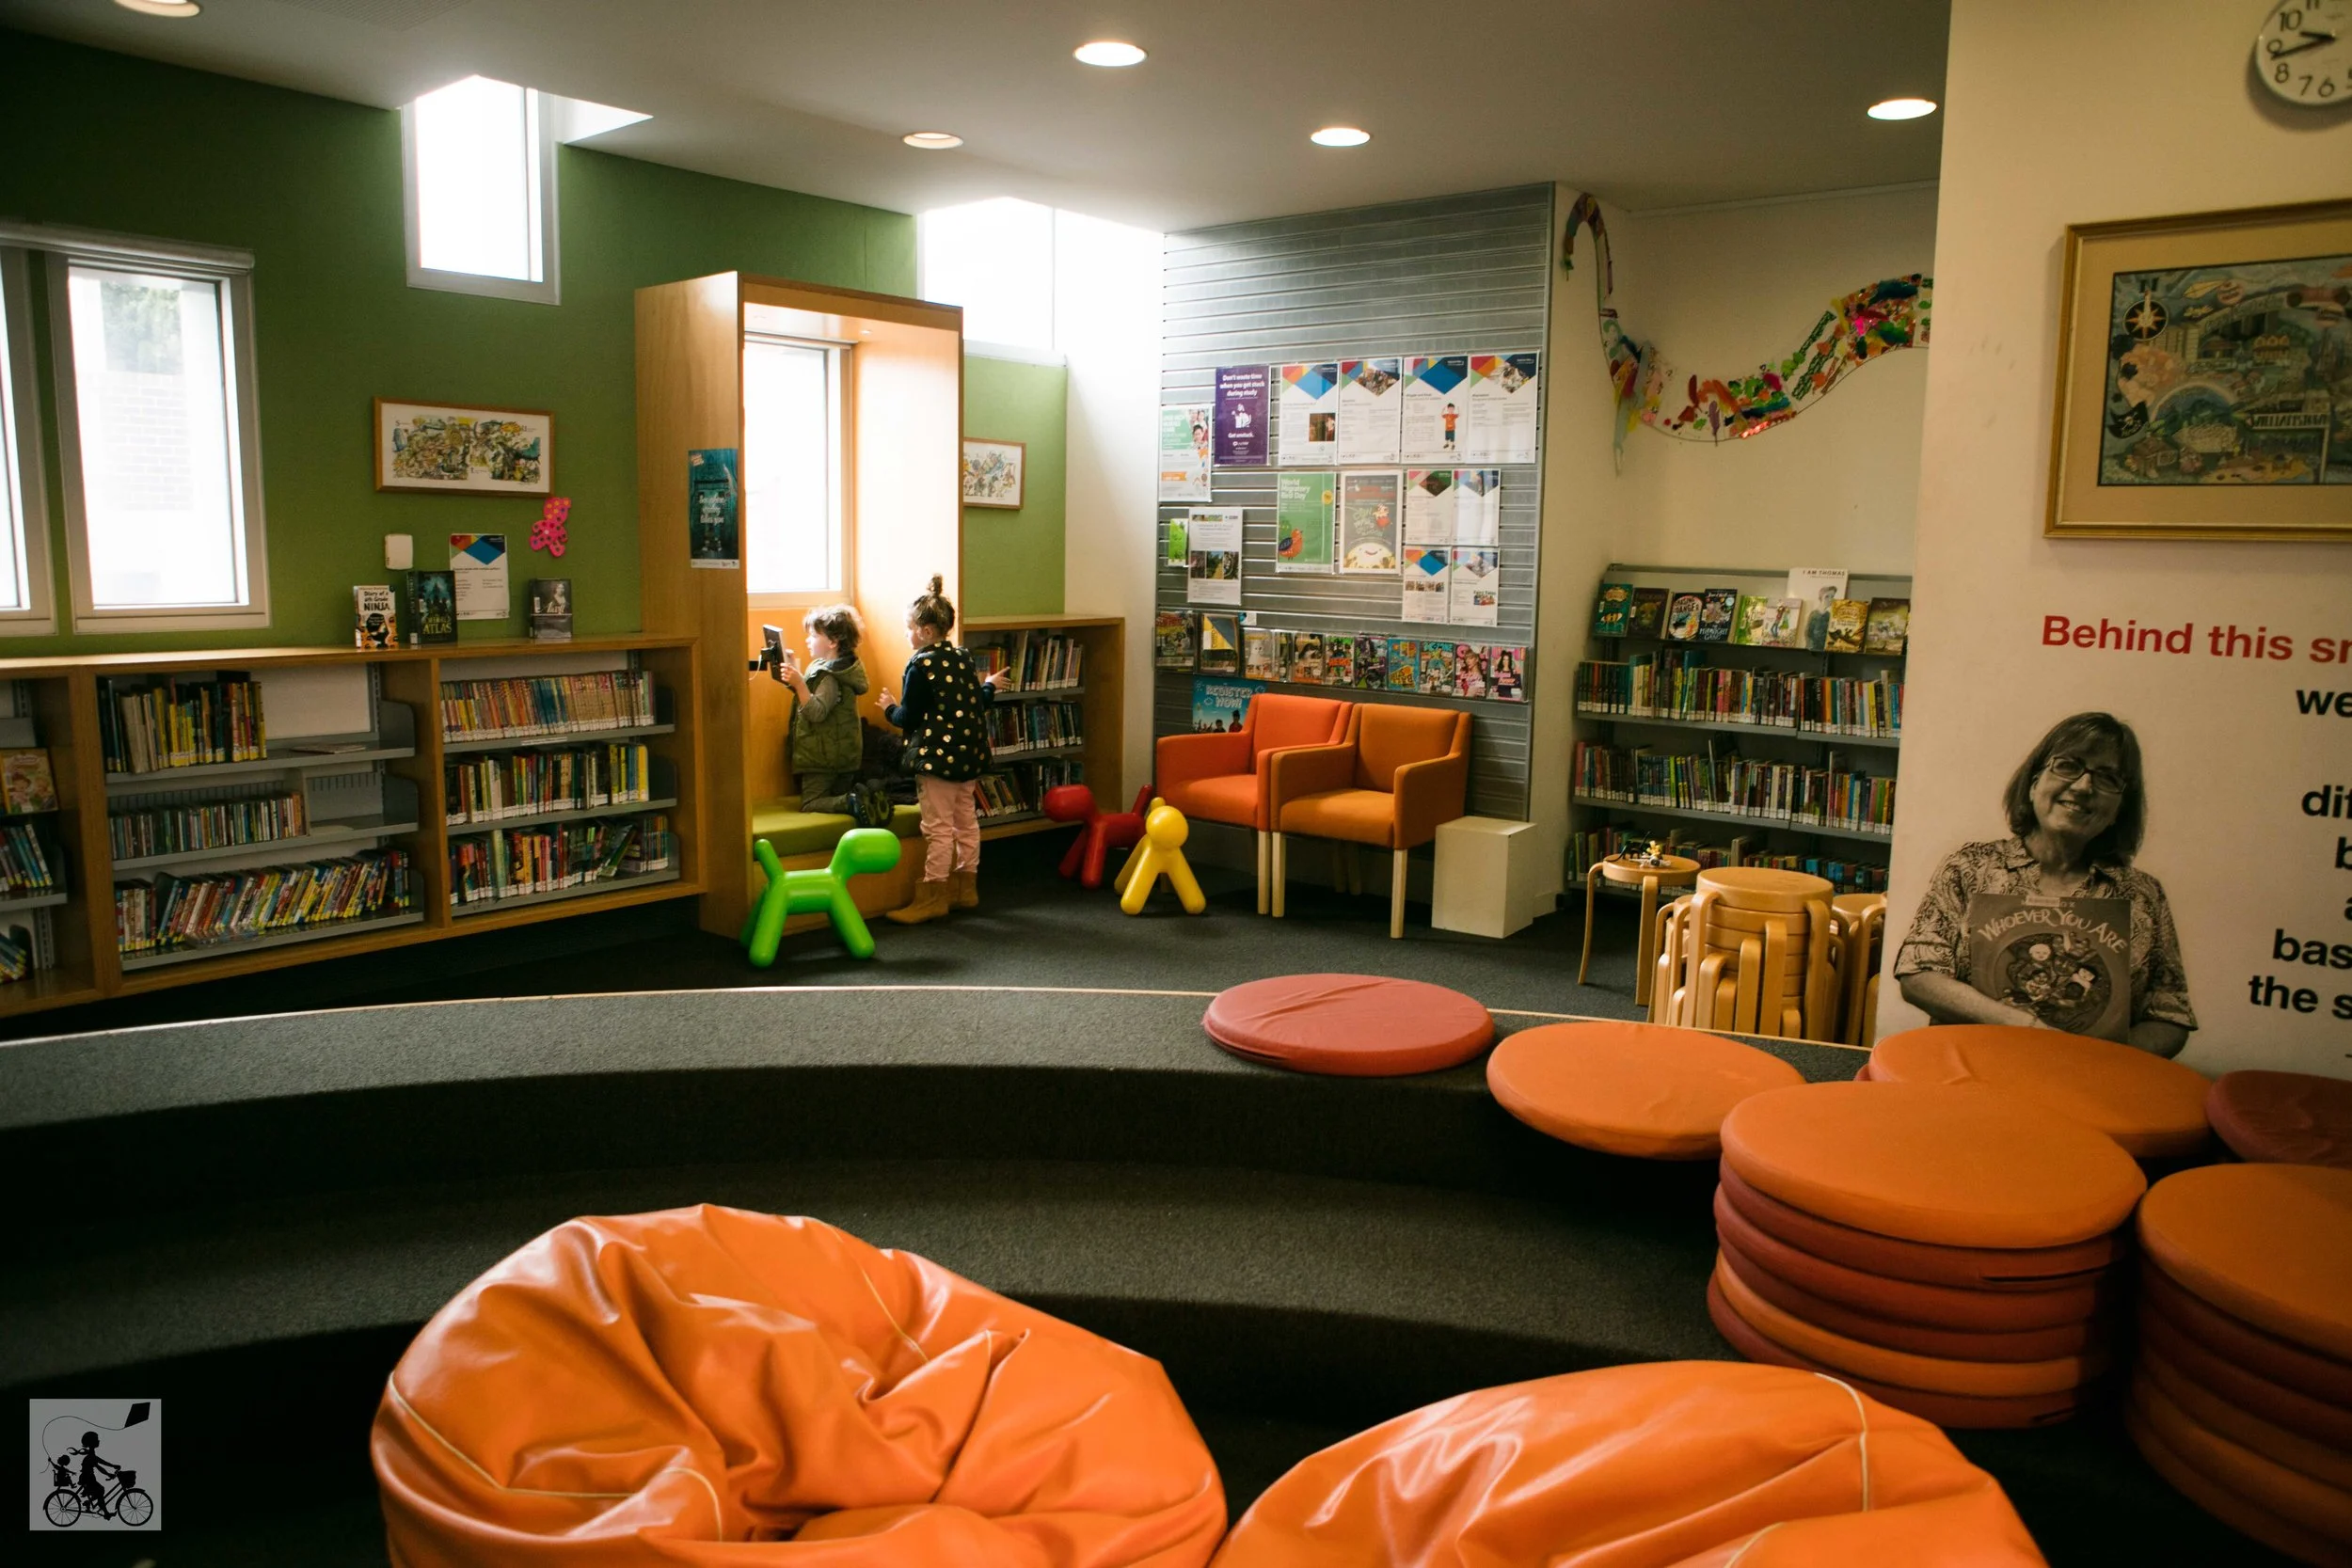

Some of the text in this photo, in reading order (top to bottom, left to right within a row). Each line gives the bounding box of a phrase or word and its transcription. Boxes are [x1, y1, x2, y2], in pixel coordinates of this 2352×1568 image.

[2280, 8, 2302, 32] 10
[2266, 39, 2282, 60] 9
[2275, 62, 2289, 84] 8
[2298, 75, 2312, 96] 7
[2318, 77, 2335, 98] 6
[364, 602, 390, 611] NINJA
[422, 623, 452, 634] ATLAS
[2042, 615, 2194, 655] Behind
[2208, 625, 2293, 661] this
[1978, 908, 2128, 954] WHOEVER YOU ARE
[2273, 928, 2352, 970] bas
[2248, 974, 2318, 1014] the
